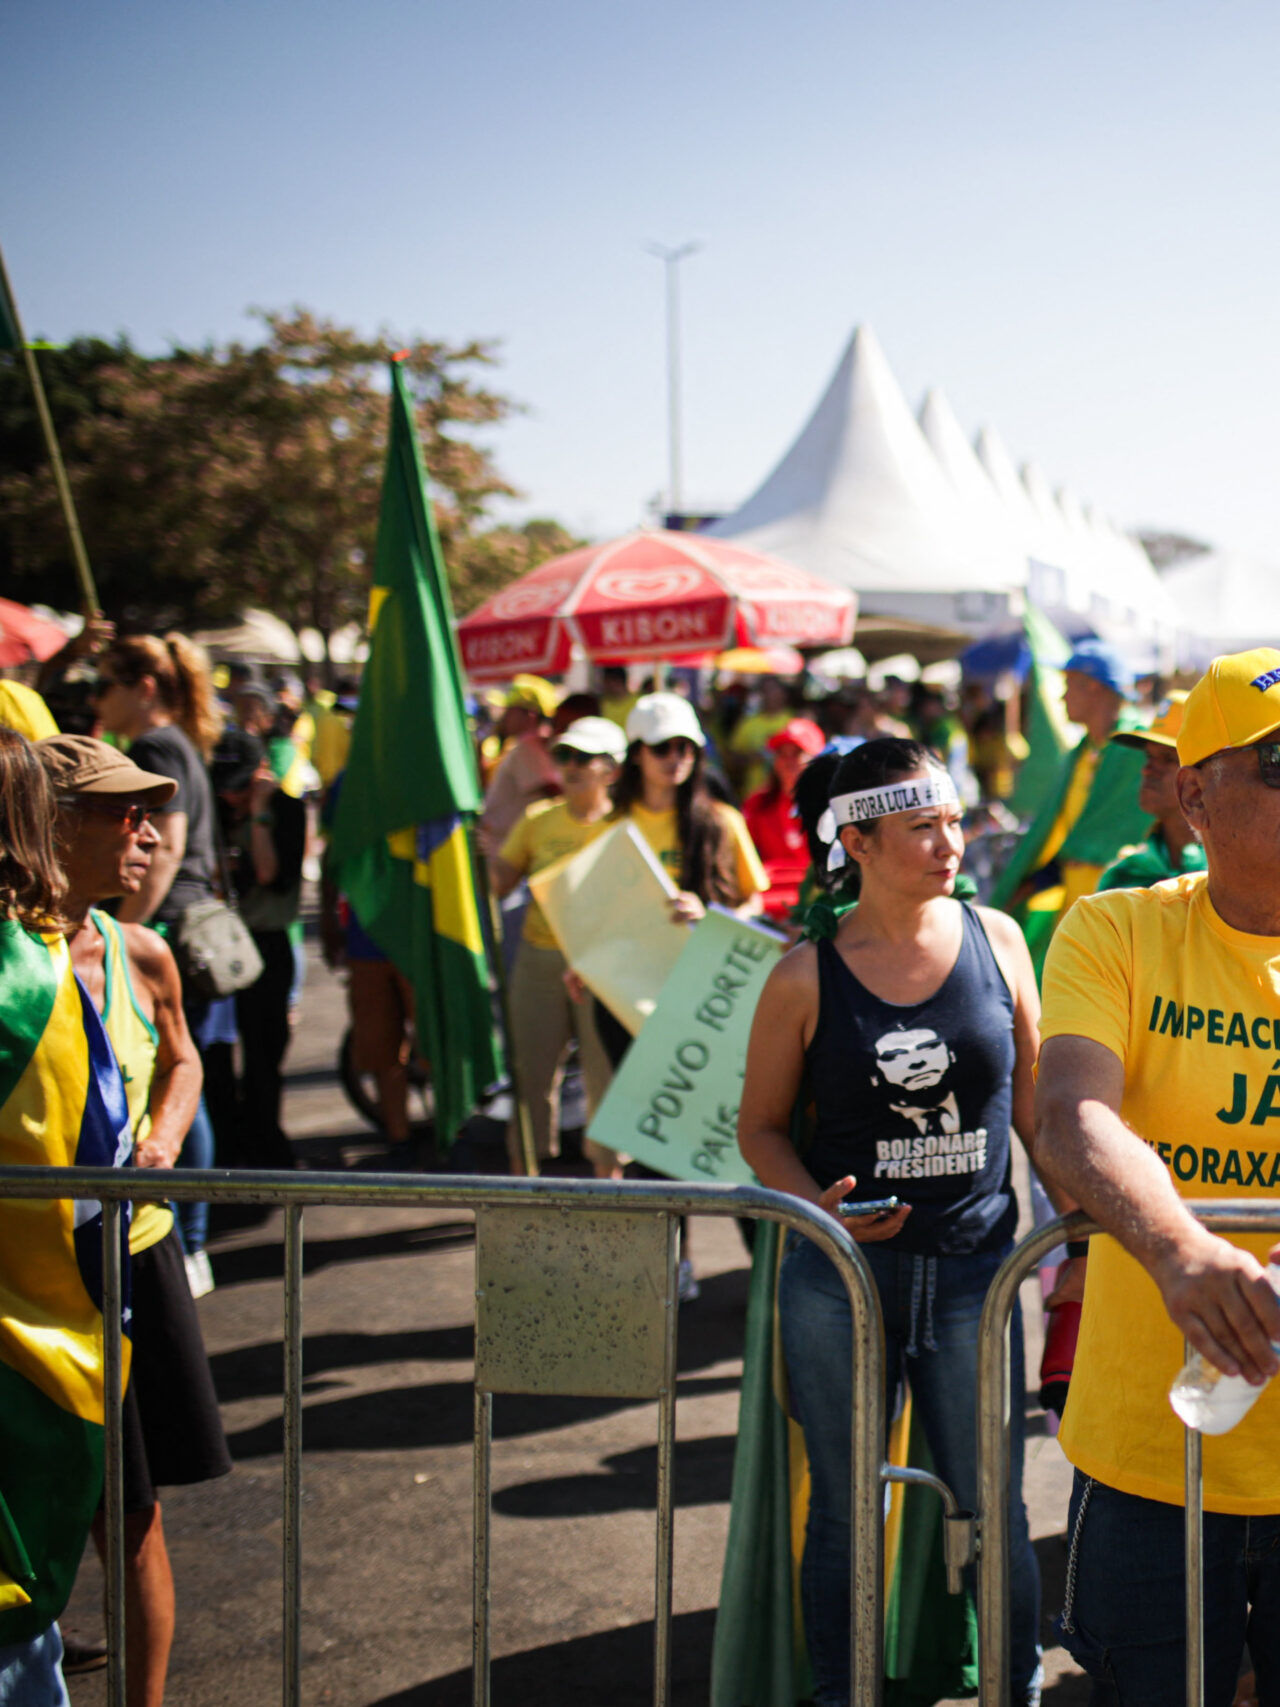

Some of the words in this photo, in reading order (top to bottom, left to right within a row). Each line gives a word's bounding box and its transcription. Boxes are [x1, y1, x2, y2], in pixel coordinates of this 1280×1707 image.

[601, 604, 709, 646] KIBON
[636, 1038, 710, 1145] POVO
[876, 1128, 988, 1161] BOLSONARO
[874, 1149, 988, 1179] PRESIDENTE
